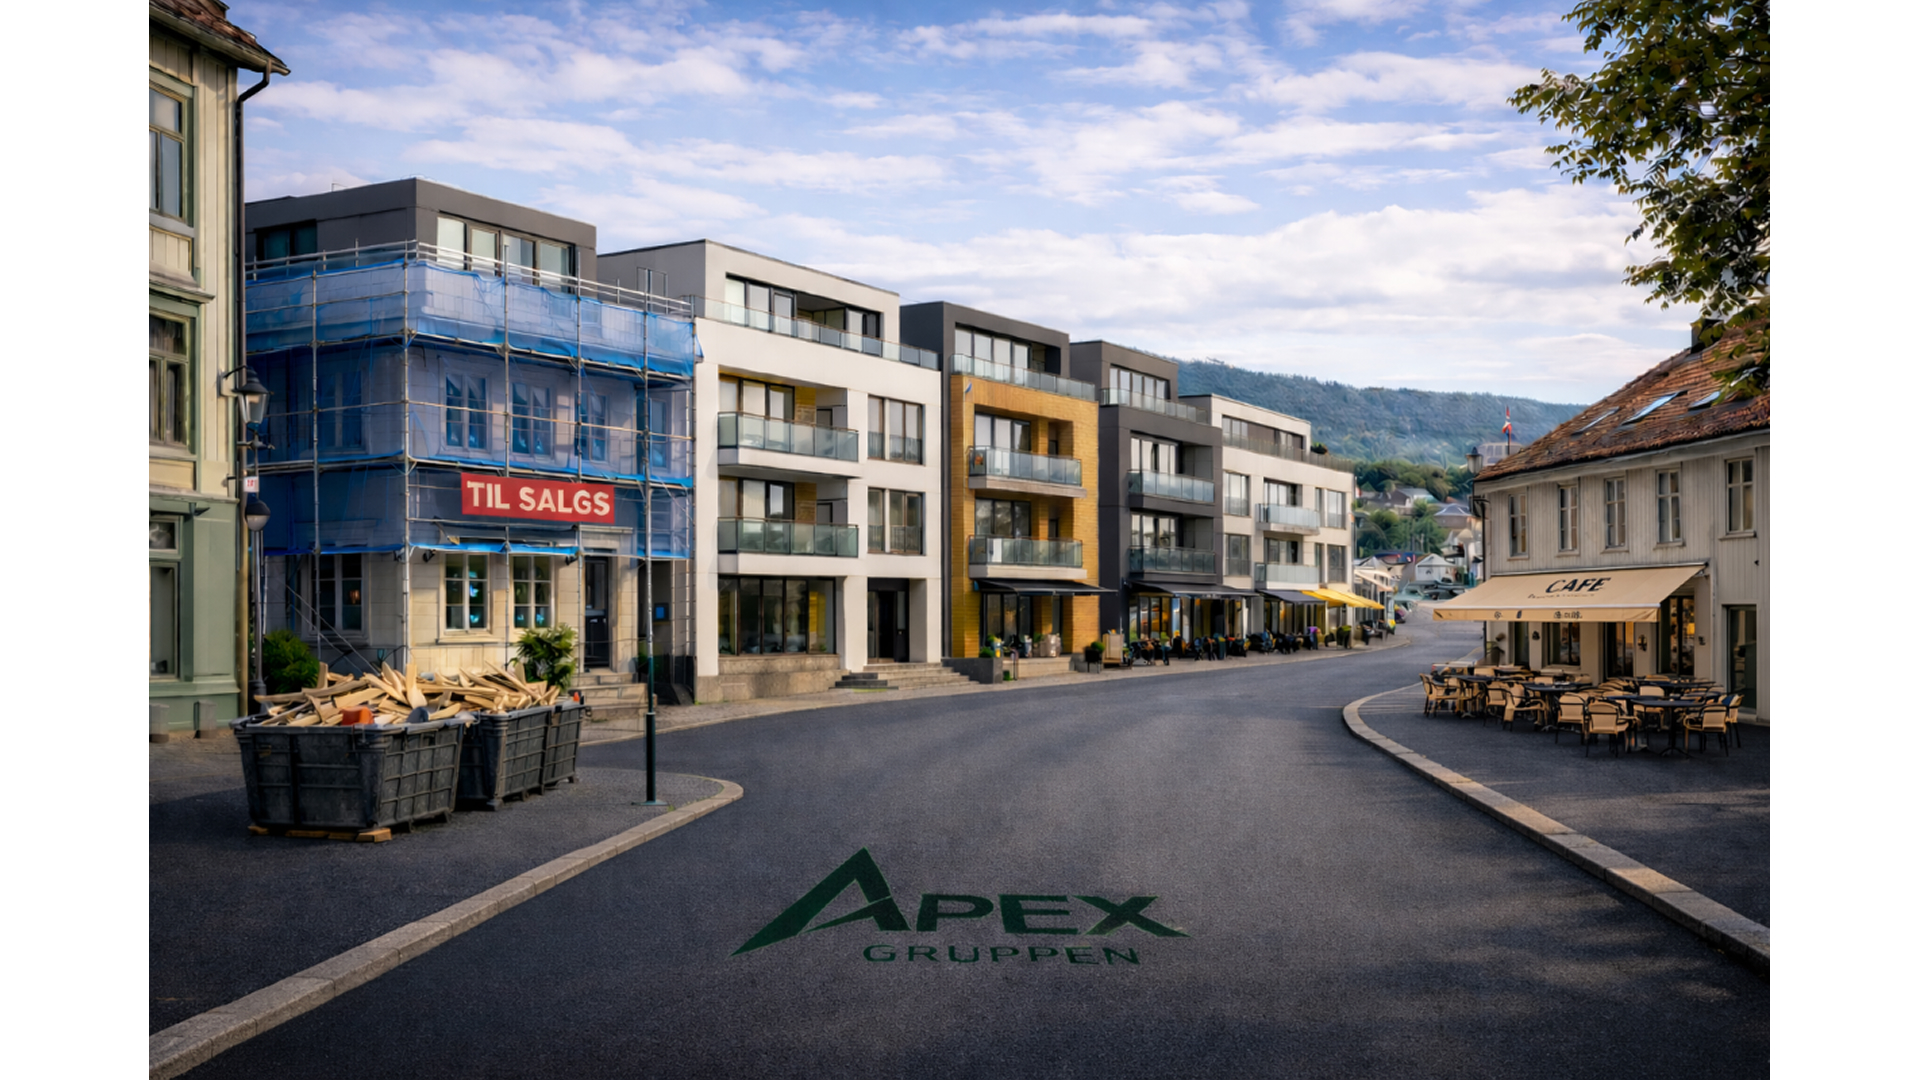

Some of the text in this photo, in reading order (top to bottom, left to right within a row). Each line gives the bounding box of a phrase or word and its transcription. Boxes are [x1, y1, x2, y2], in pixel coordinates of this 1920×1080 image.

[466, 480, 611, 516] TIL SALGS
[1545, 577, 1612, 593] CAFE
[728, 847, 1192, 957] APEX
[862, 944, 1141, 966] GRUPPEN
